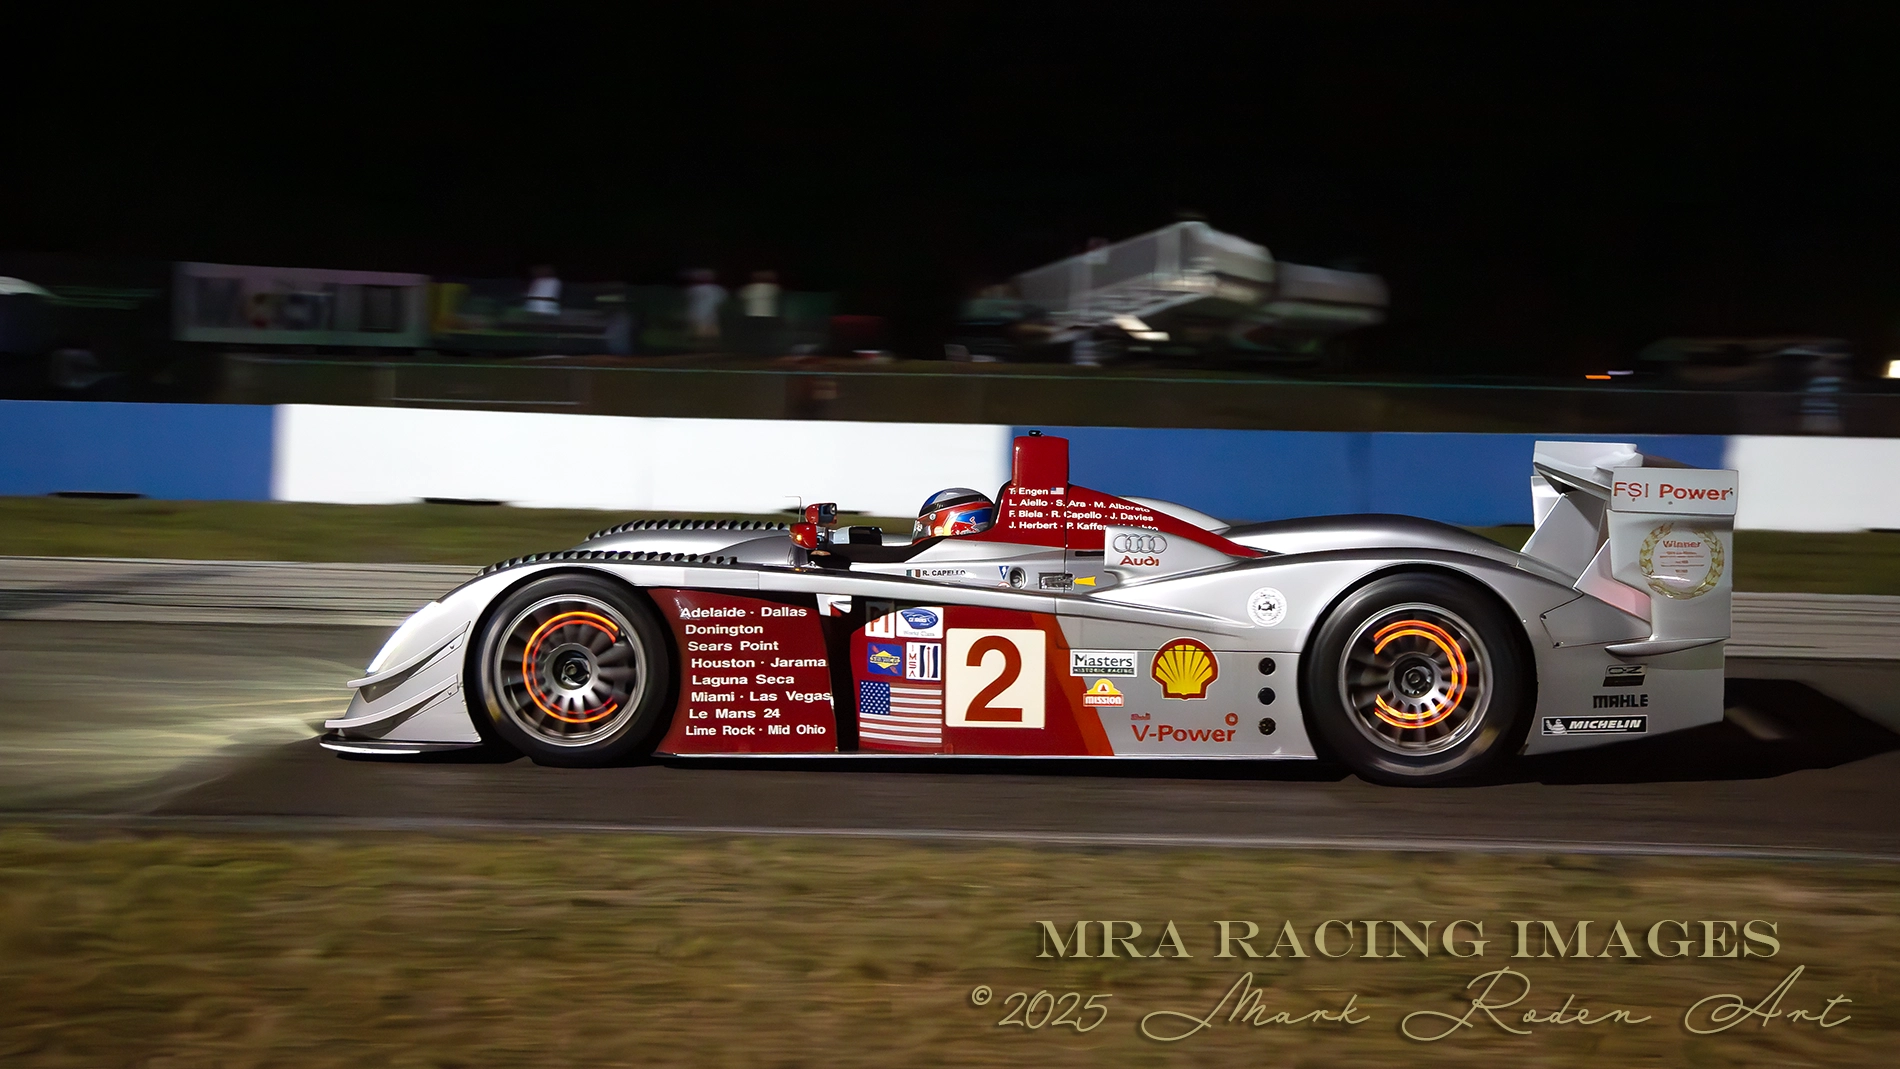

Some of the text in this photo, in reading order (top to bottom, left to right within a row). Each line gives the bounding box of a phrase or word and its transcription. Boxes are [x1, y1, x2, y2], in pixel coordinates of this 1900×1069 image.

[1019, 488, 1048, 496] Engen
[1614, 482, 1730, 501] FSI Power
[1067, 500, 1086, 508] Ara
[1109, 501, 1151, 512] Alboreto
[1064, 511, 1102, 519] Capello
[1121, 511, 1153, 521] Davies
[1663, 540, 1701, 548] Winner
[1121, 556, 1159, 566] Audi
[680, 606, 807, 618] Adelaide Dallas
[686, 624, 763, 636] Donington
[688, 641, 778, 651] Sears Point
[692, 658, 826, 668] Houston Jarama
[909, 645, 917, 677] IMSA
[1075, 654, 1132, 666] Masters
[693, 674, 794, 687] Laguna Seca
[966, 636, 1022, 722] 2
[692, 691, 831, 704] Miami Las Vegas
[1593, 694, 1648, 708] MAHLE
[689, 708, 780, 718] Le Mans 24
[686, 725, 826, 735] Lime Rock Mid Ohio
[1569, 720, 1641, 730] MICHELIN
[1131, 724, 1237, 742] V-Power
